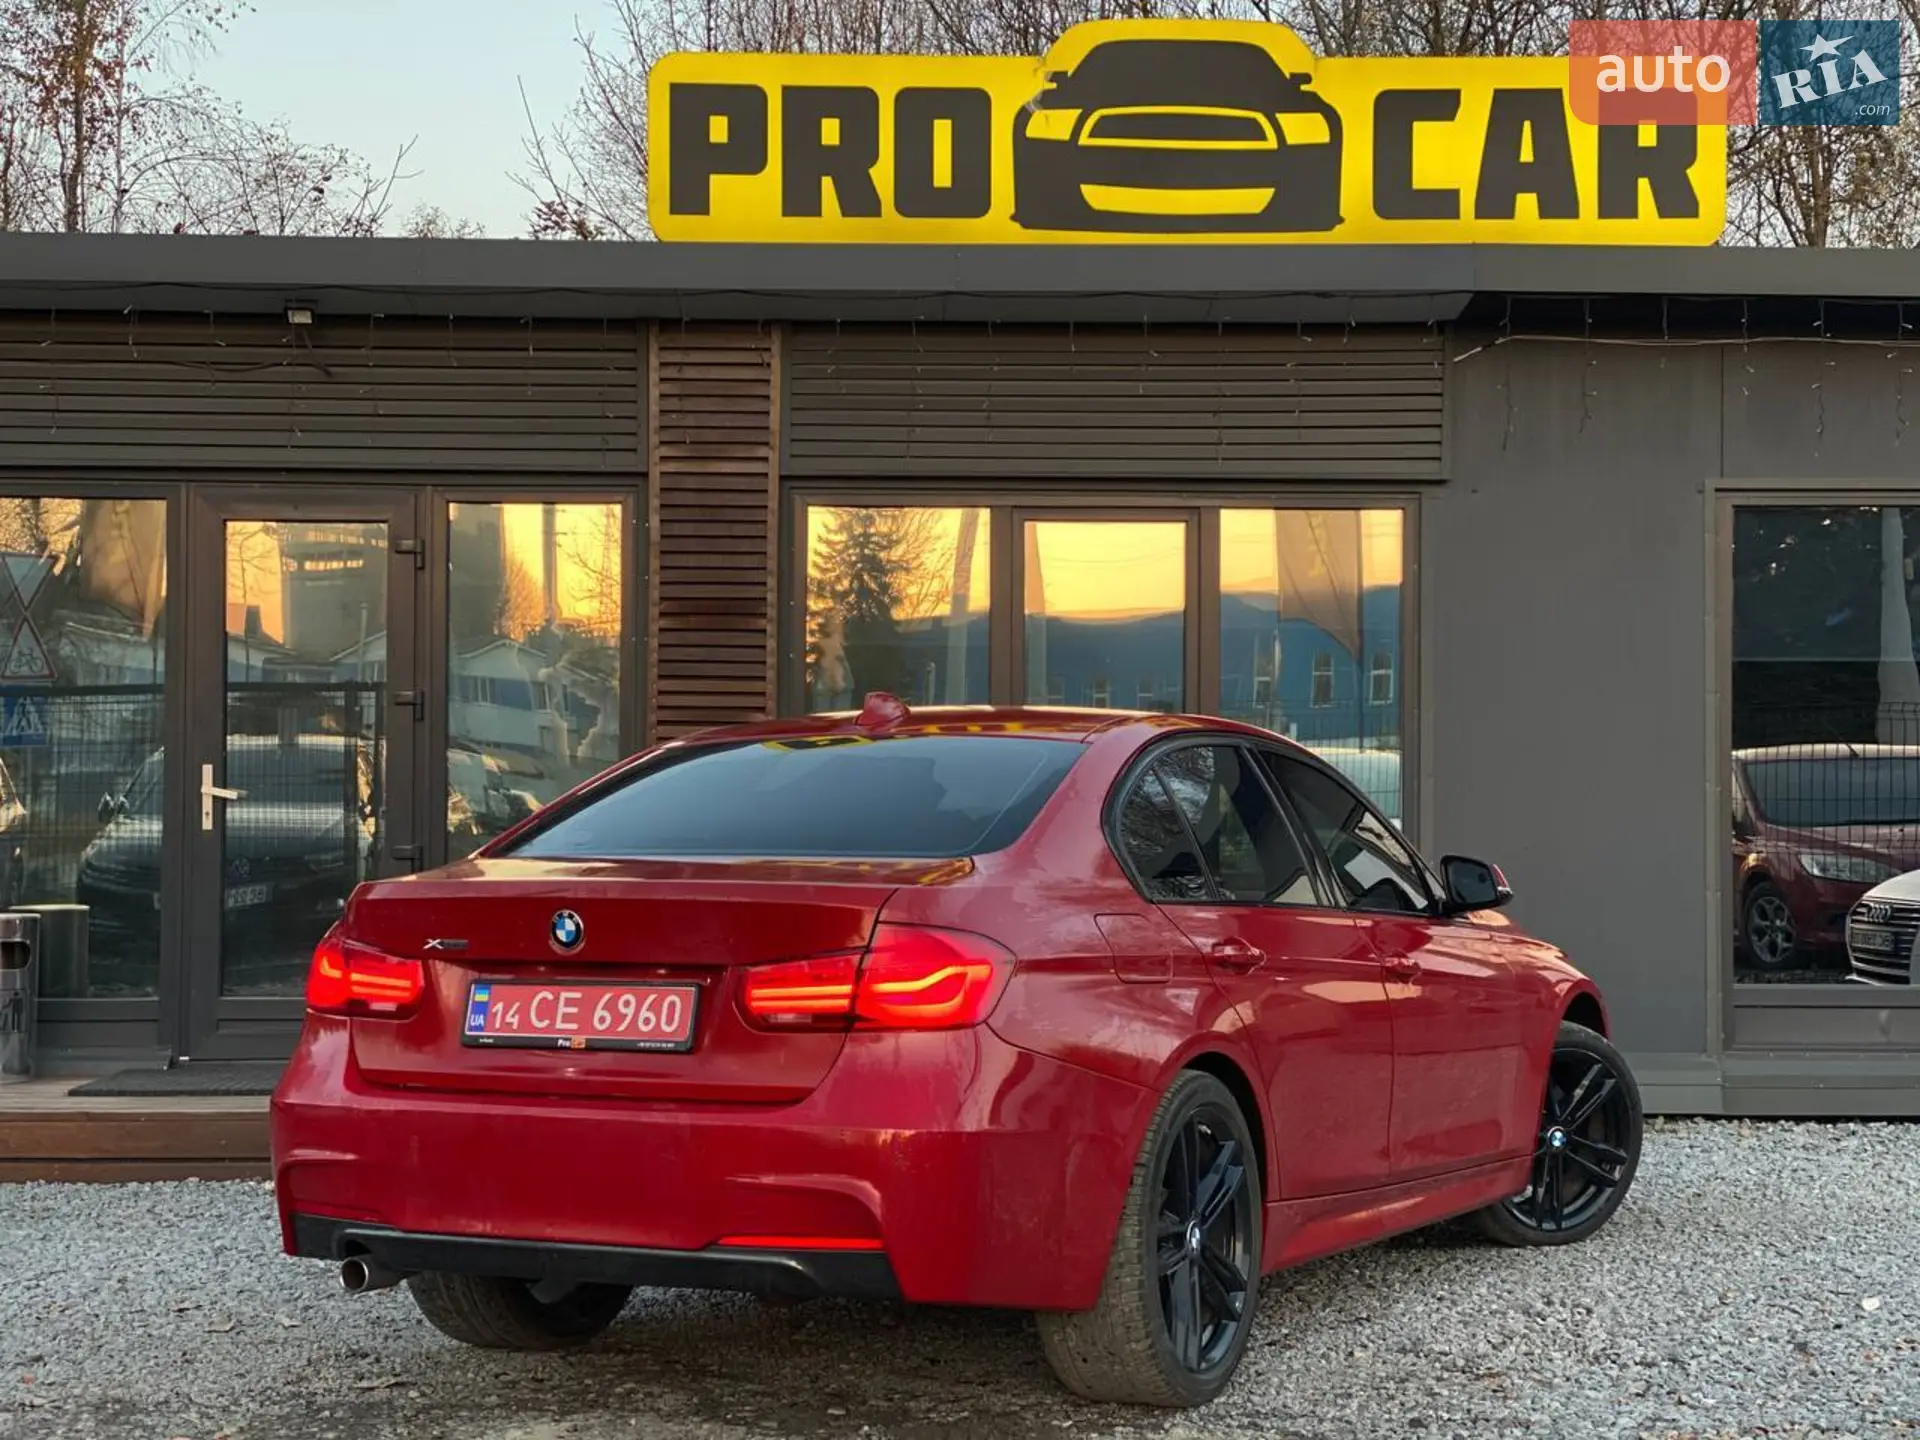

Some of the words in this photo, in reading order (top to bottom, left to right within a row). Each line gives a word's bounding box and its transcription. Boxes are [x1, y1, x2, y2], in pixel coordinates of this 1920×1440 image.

[669, 82, 992, 219] PRO
[1373, 87, 1700, 220] CAR
[470, 1014, 485, 1027] UA
[491, 1001, 520, 1030] 14
[530, 991, 583, 1030] CE
[592, 992, 682, 1033] 6960
